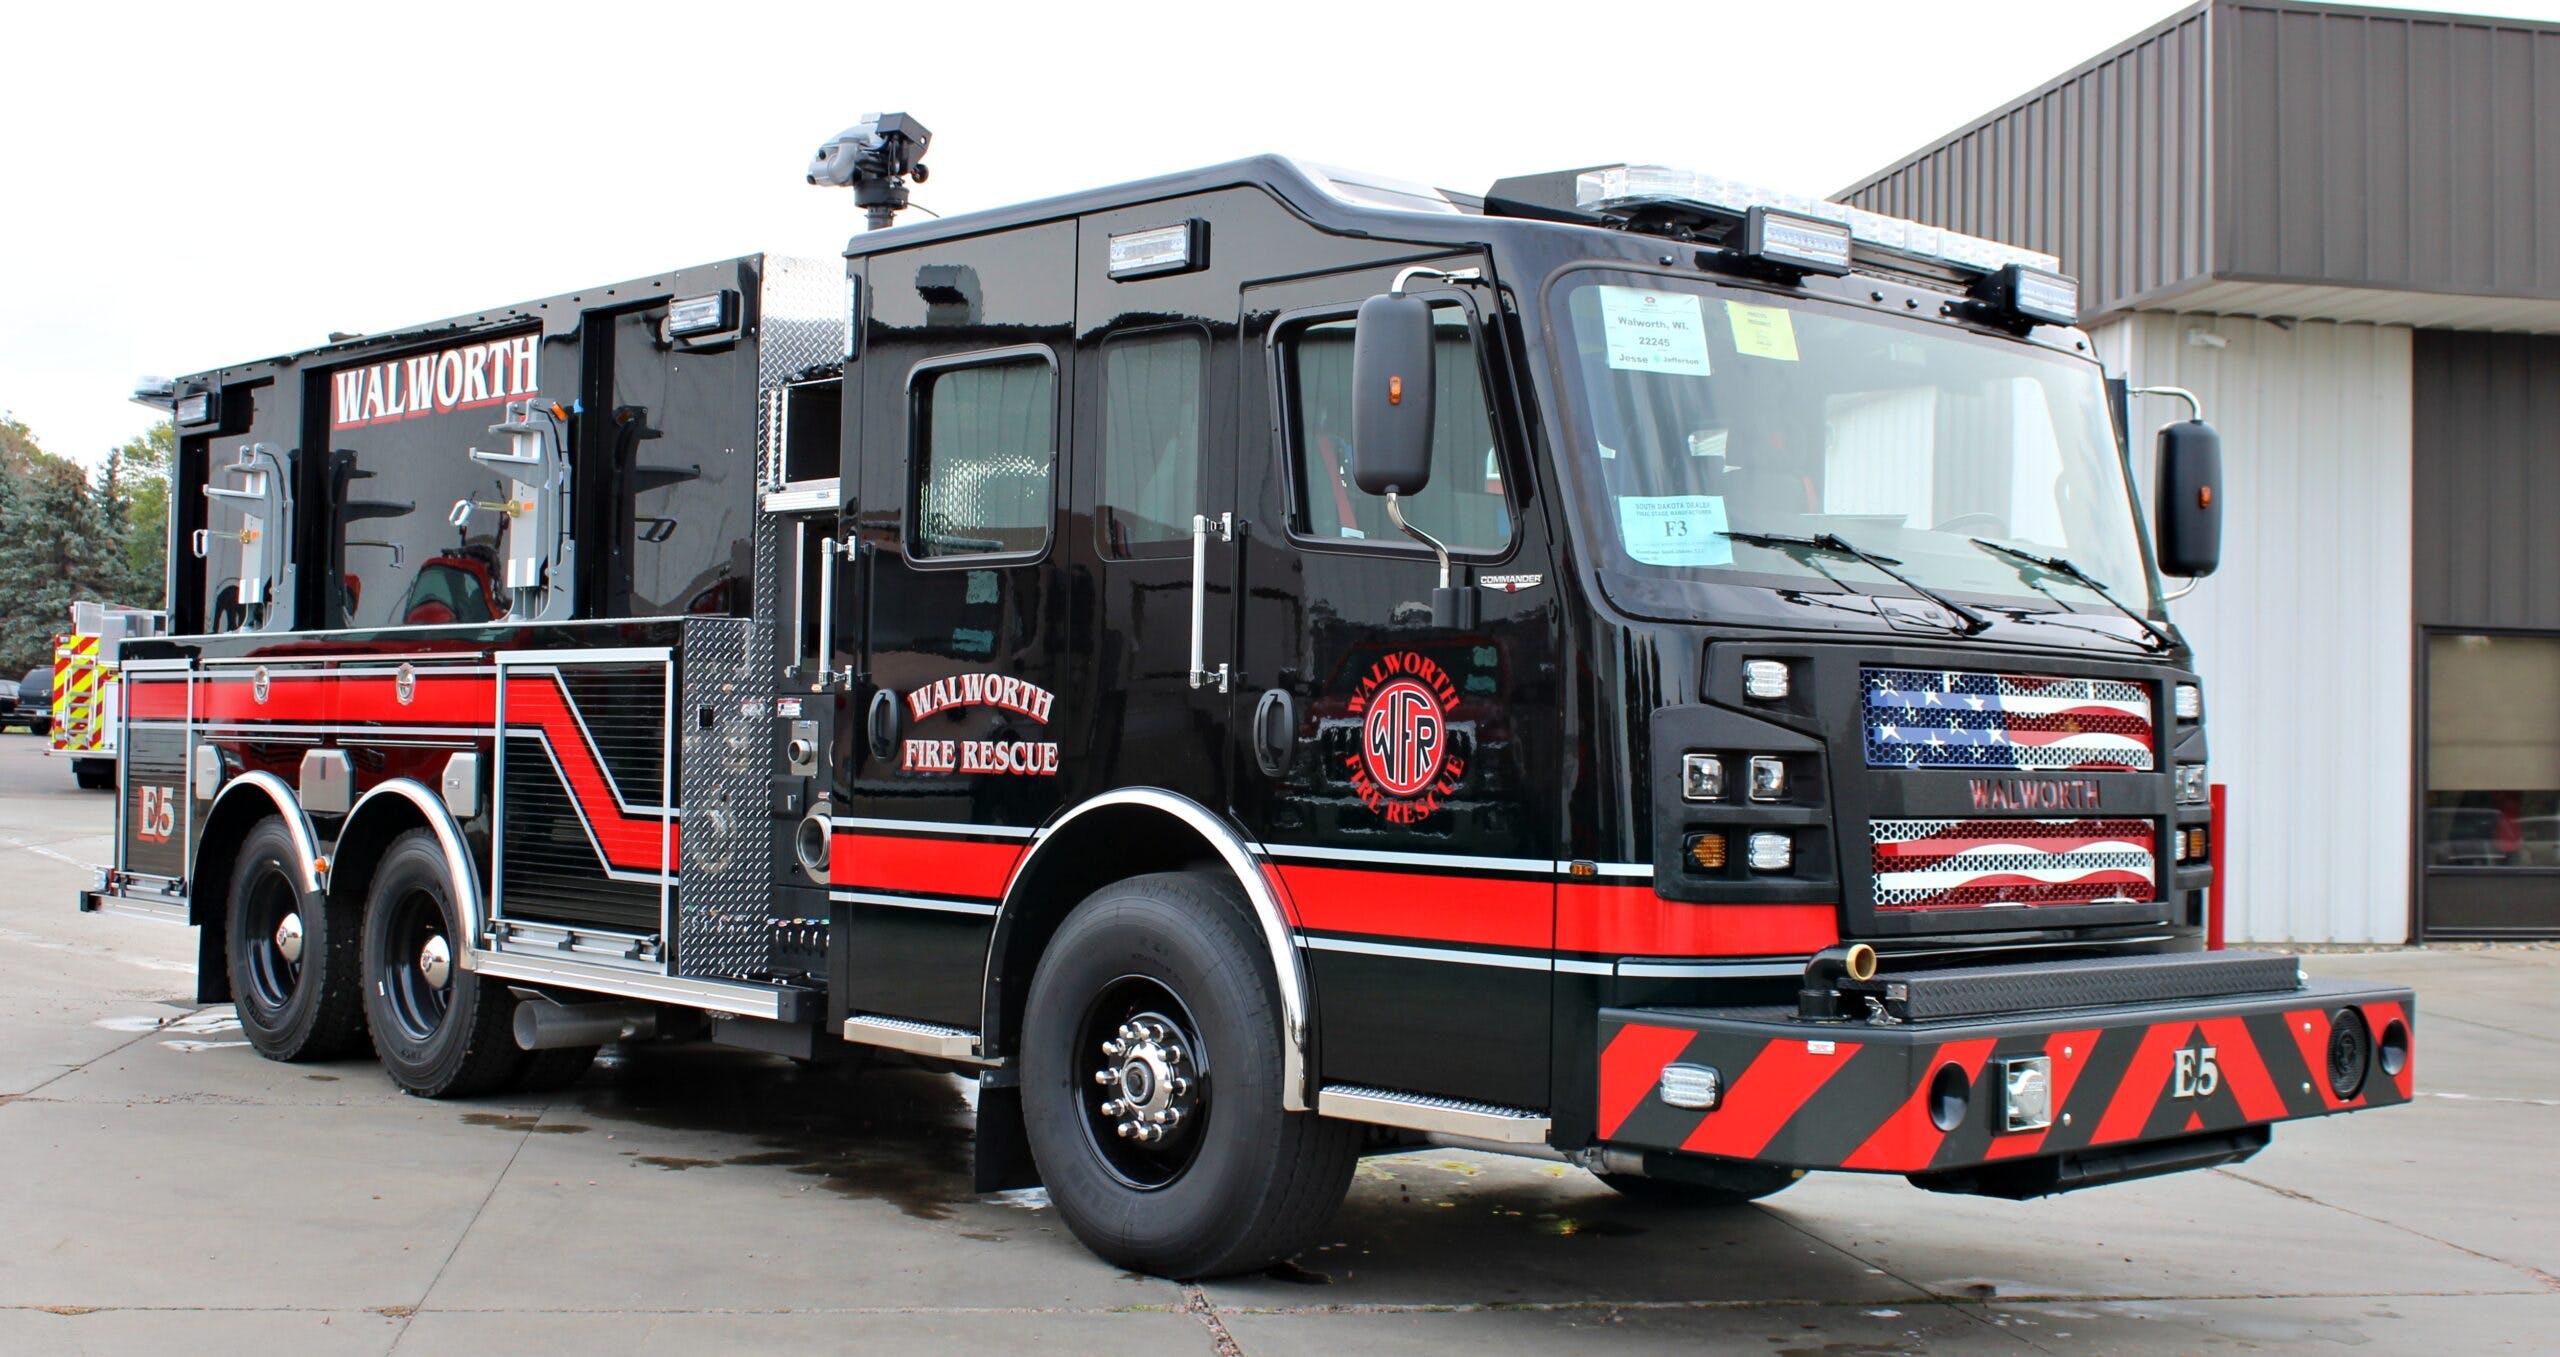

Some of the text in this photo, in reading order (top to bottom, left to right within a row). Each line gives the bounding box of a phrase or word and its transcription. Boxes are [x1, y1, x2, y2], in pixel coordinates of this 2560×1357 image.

[1619, 353, 1700, 366] Jesse Jefferson
[1638, 336, 1671, 347] 22245
[332, 334, 540, 429] WALWORTH
[1657, 502, 1684, 510] DAKOTA
[1664, 520, 1688, 537] F3
[1480, 574, 1542, 584] COMMANDER
[907, 673, 1055, 724] WALWORTH
[1347, 651, 1460, 713] WALWORTH
[902, 739, 1059, 776] FIRE RESCUE
[1345, 753, 1465, 824] FIRE RESCUE
[1969, 778, 2101, 809] WALWORTH
[137, 784, 175, 841] E5
[2173, 1047, 2218, 1097] E5
